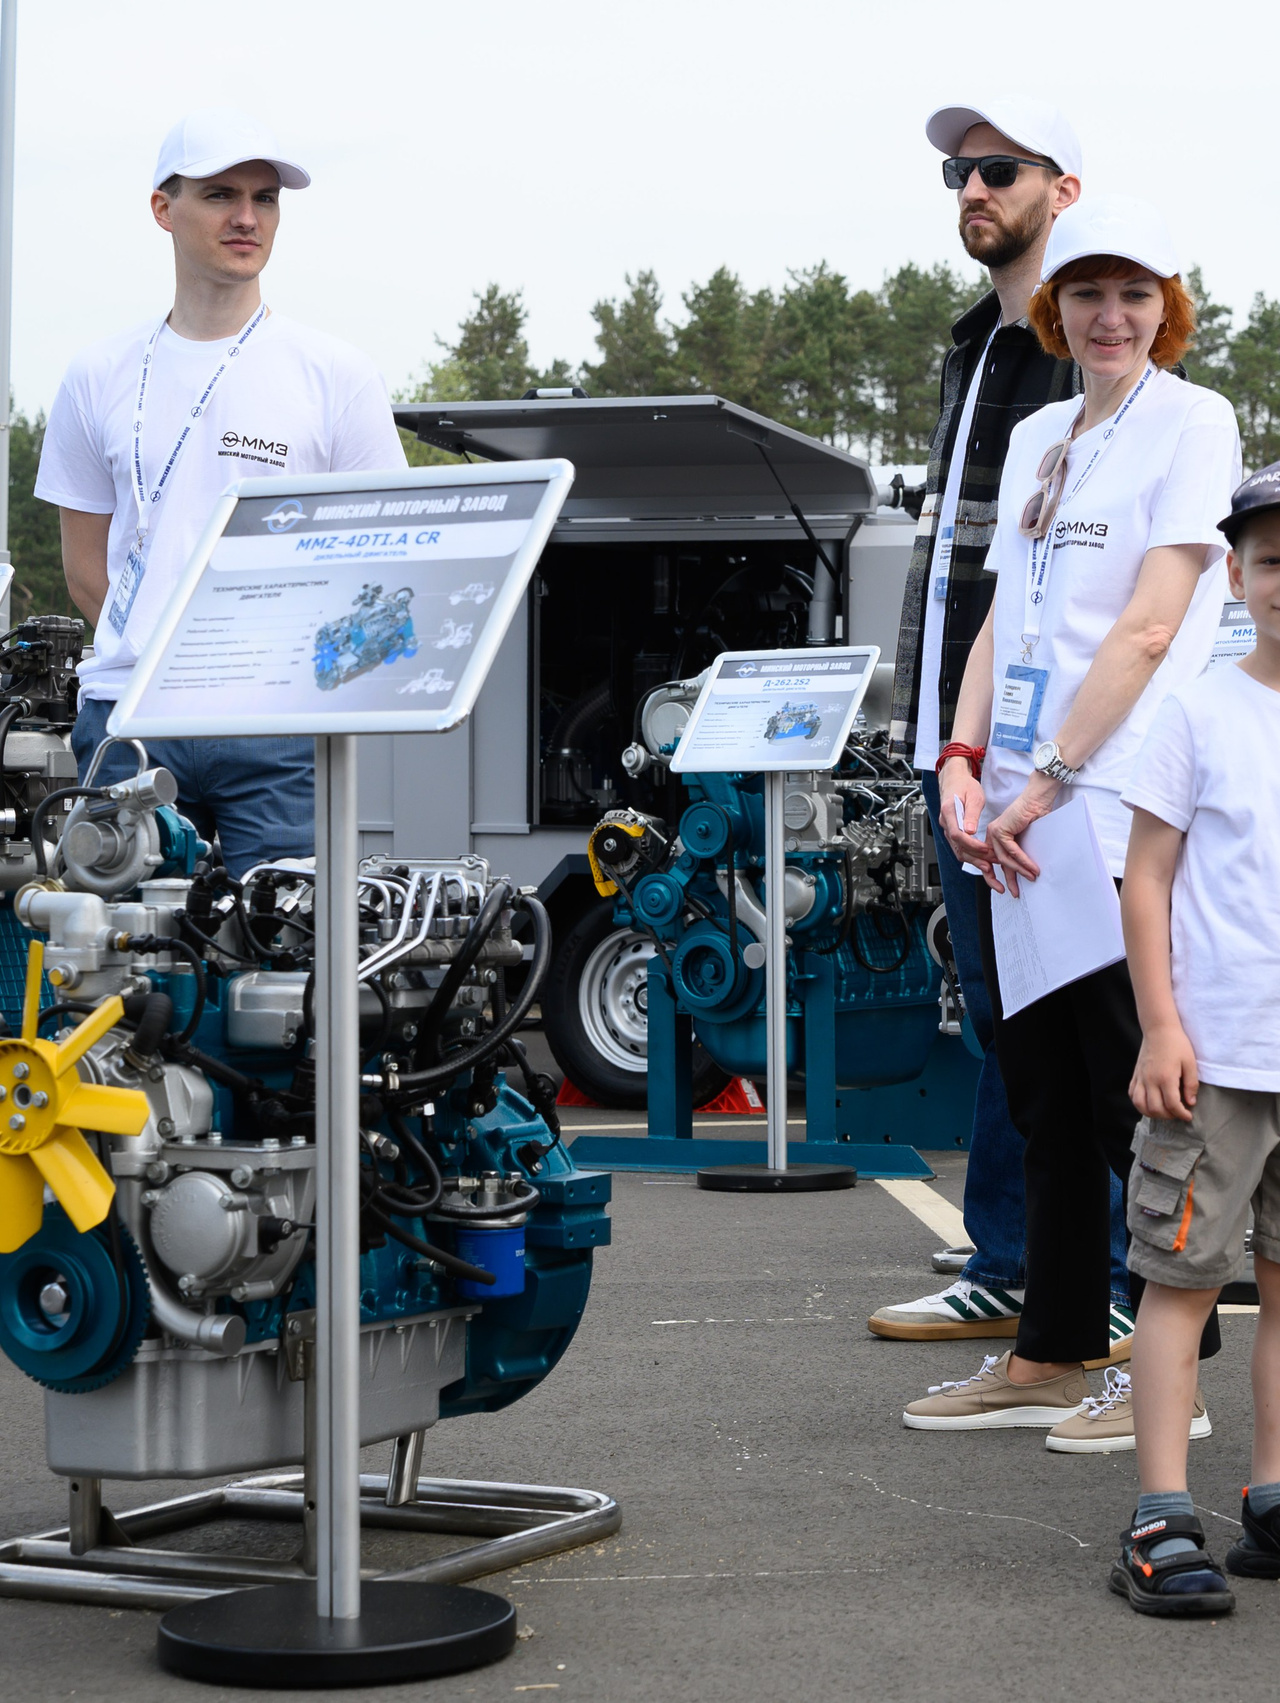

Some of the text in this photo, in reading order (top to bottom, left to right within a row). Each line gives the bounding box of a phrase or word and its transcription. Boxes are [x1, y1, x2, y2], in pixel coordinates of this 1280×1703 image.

[158, 426, 191, 487] МИНСКИЙ МОТОРНЫЙ ЗАВОД
[217, 450, 286, 468] МИНСКИЙ МОТОРНЫЙ ЗАВОД
[135, 459, 143, 486] МОТОРНЫЙ
[312, 494, 509, 521] МИНСКИЙ МОТОРНЫЙ ЗАВОД
[295, 531, 441, 552] MMZ-4DTI.A CR
[1088, 541, 1105, 550] ЗАВОД
[1037, 560, 1047, 586] МИНСКИЙ
[263, 580, 329, 590] ХАРАКТЕРИСТИКИ
[238, 592, 282, 601] ДВИГАТЕЛЯ
[760, 661, 852, 673] МИНСКИЙ МОТОРНЫЙ ЗАВОД
[763, 678, 811, 688] Д-262.2S2
